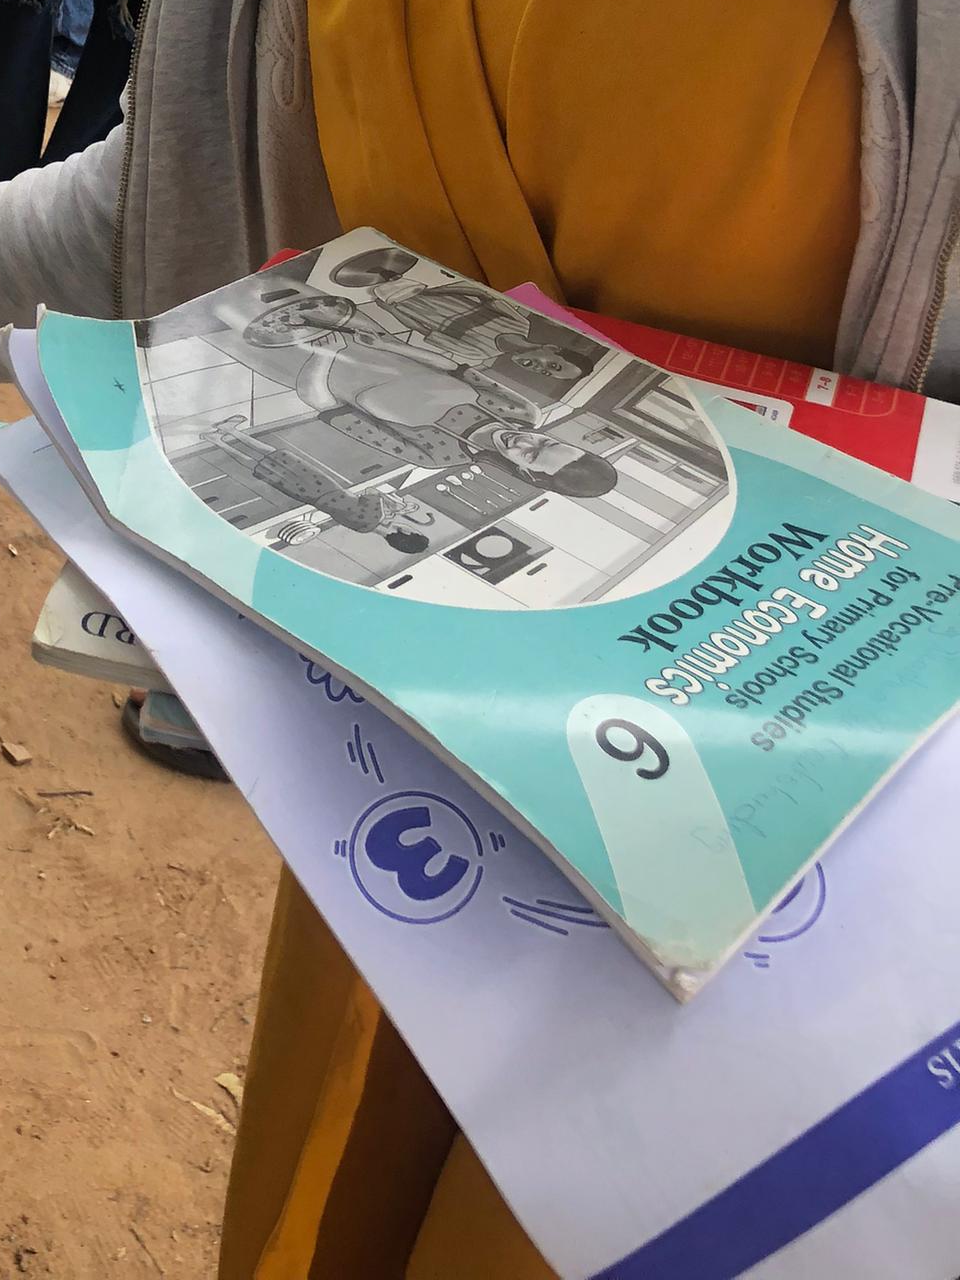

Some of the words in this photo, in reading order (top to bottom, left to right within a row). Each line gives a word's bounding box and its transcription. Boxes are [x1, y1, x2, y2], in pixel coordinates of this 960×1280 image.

[617, 521, 827, 656] Workbook
[798, 523, 910, 607] Home
[885, 564, 921, 604] for
[643, 585, 827, 708] Economics
[797, 584, 885, 655] Primary
[725, 627, 816, 714] Schools
[594, 718, 670, 781] 6
[750, 675, 844, 754] Studies
